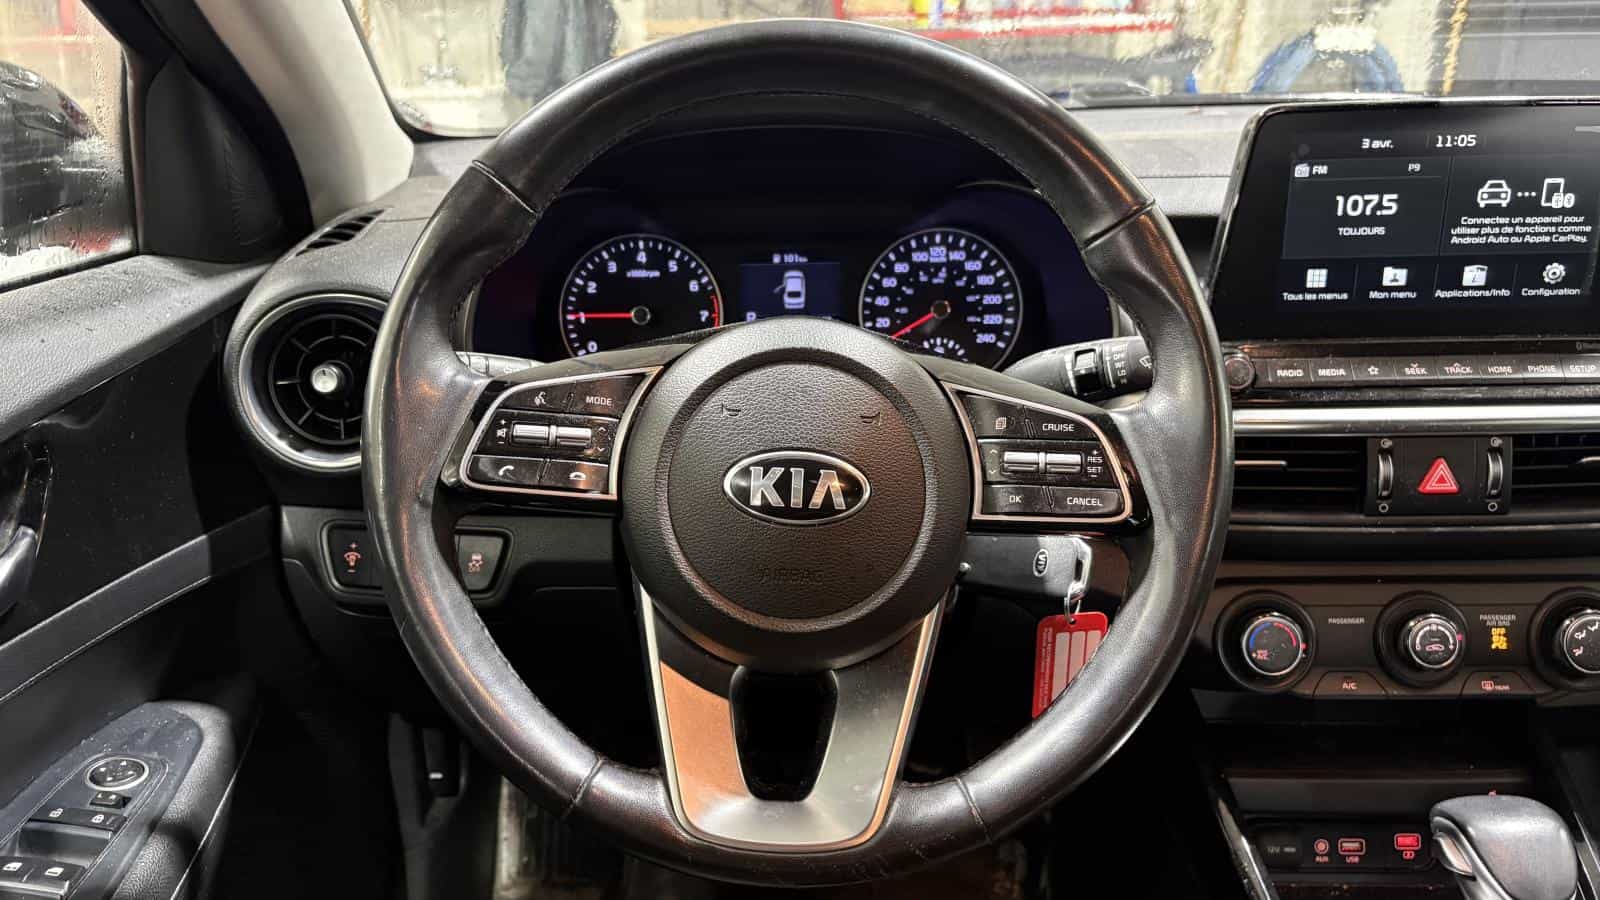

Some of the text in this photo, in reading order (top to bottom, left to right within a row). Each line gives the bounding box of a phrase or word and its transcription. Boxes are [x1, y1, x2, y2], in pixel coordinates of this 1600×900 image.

[1361, 138, 1394, 149] 3 avr.
[1435, 134, 1477, 147] 11:05
[1312, 165, 1328, 175] FM
[1336, 194, 1398, 216] 107.5
[1461, 216, 1584, 225] Connectez un appareil pour
[1338, 227, 1385, 236] TOUJOURS
[1451, 226, 1480, 234] utiliser
[1481, 226, 1499, 234] plus
[1515, 225, 1555, 233] fonctions
[1451, 236, 1485, 244] Android
[1488, 235, 1509, 243] Auto
[1524, 234, 1550, 243] Apple
[1552, 234, 1588, 242] CarPlay.
[929, 246, 946, 256] 120
[949, 251, 966, 261] 140
[636, 251, 646, 263] 4
[911, 252, 929, 262] 100
[608, 261, 617, 272] 3
[668, 260, 678, 272] 5
[894, 262, 909, 273] 80
[965, 261, 982, 271] 160
[882, 277, 897, 288] 60
[977, 275, 995, 285] 180
[587, 281, 597, 293] 2
[689, 280, 699, 292] 6
[1282, 292, 1348, 301] Tous les menus
[1369, 291, 1417, 299] Mon menu
[1435, 289, 1510, 298] Applications/Info
[1521, 288, 1581, 297] Configuration
[875, 296, 890, 306] 40
[983, 294, 1002, 304] 200
[700, 310, 709, 322] 7
[983, 314, 1003, 325] 220
[876, 318, 890, 327] 20
[976, 333, 996, 344] 240
[588, 341, 597, 353] 0
[1276, 369, 1304, 377] RADIO
[1318, 368, 1346, 377] MEDIA
[1404, 367, 1428, 375] SEEK
[1444, 366, 1472, 374] TRACK
[1488, 366, 1512, 374] HOME
[1528, 365, 1556, 373] PHONE
[1570, 365, 1597, 373] SETUP
[586, 395, 613, 406] MODE
[1042, 423, 1074, 432] CRUISE
[750, 466, 846, 510] KIA
[1009, 495, 1022, 503] OK
[1066, 497, 1103, 506] CANCEL
[1342, 682, 1357, 690] A/C
